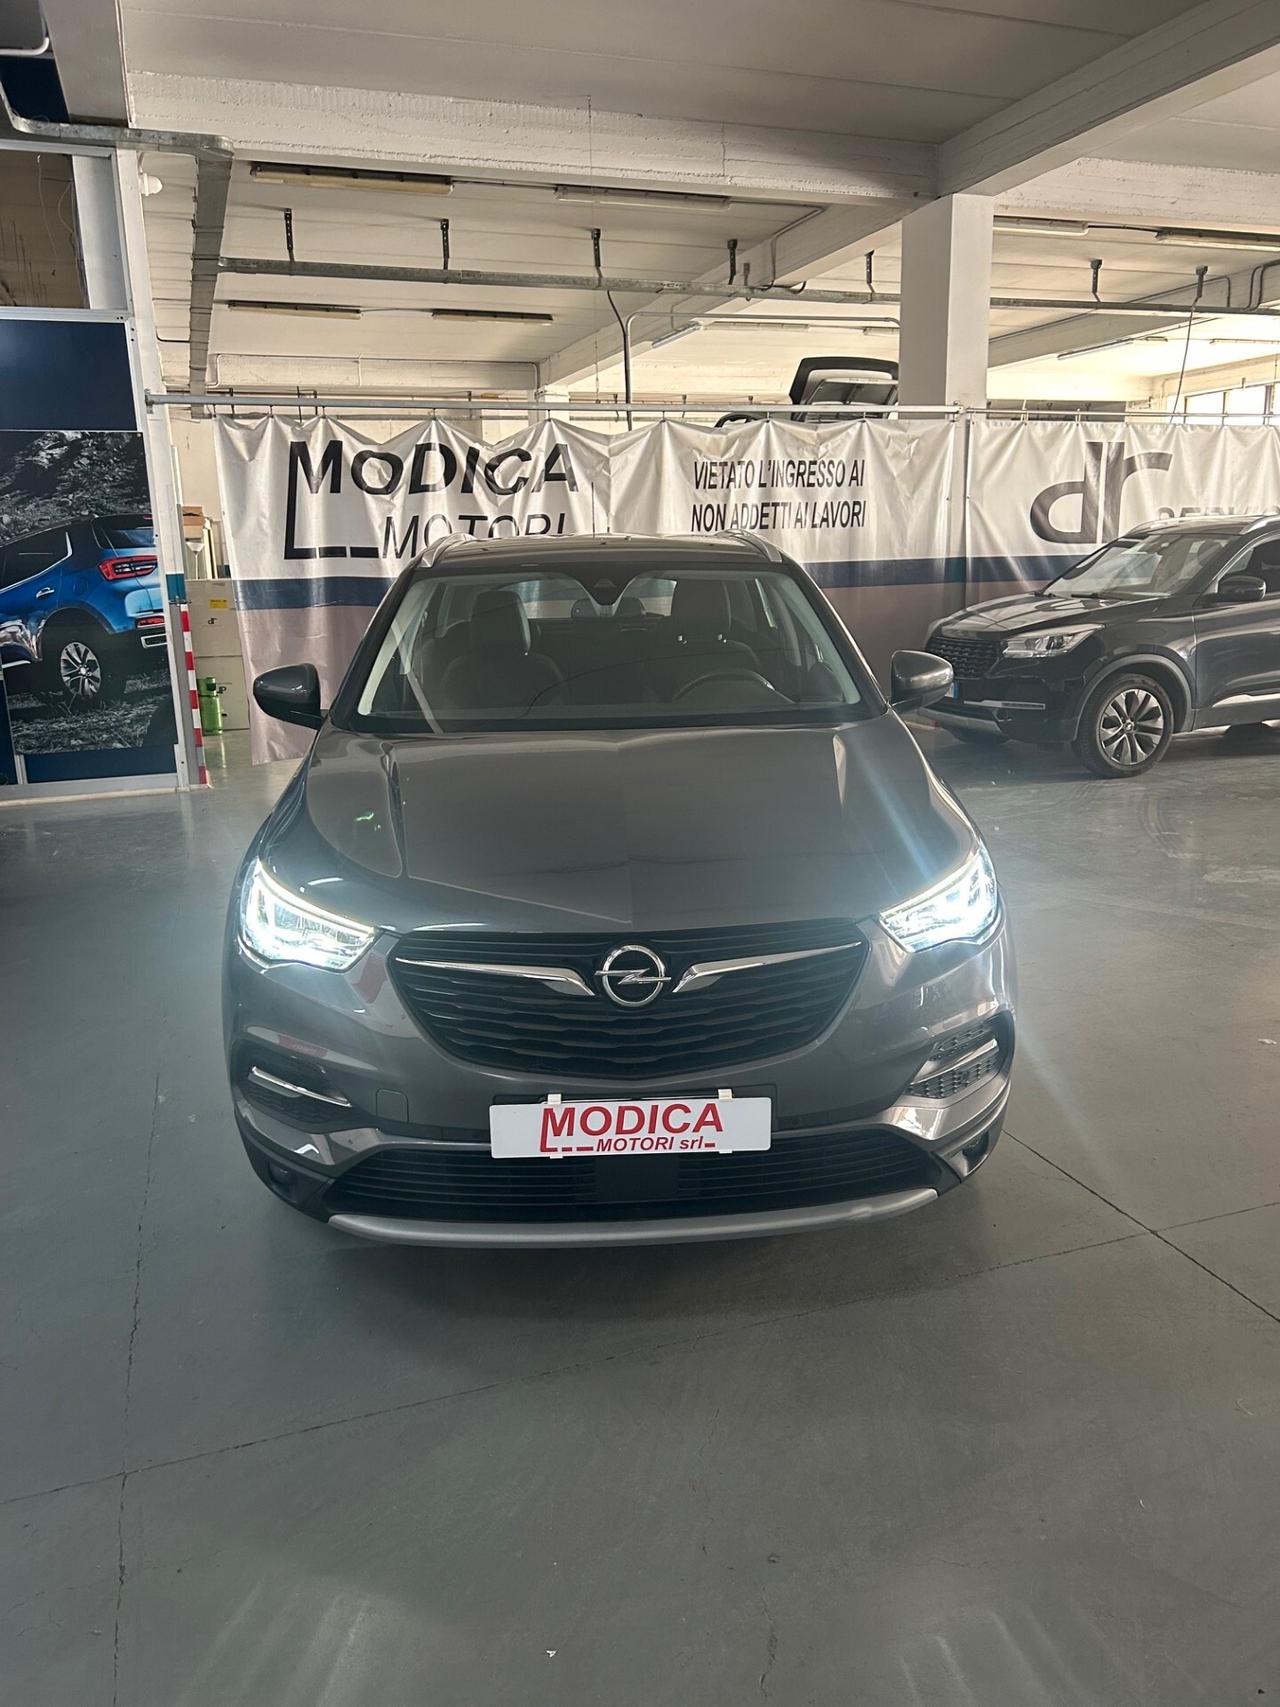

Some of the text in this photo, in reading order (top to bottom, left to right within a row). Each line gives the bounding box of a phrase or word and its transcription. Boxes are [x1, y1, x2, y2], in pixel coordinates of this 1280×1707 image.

[290, 440, 579, 495] MODICA
[694, 460, 865, 489] VIETATO L'INGRESSO AI
[1030, 441, 1173, 544] dr
[691, 500, 867, 532] NON ADDETTI AI LAVORI
[540, 1103, 723, 1137] MODICA
[596, 1136, 704, 1152] MOTORI srl
